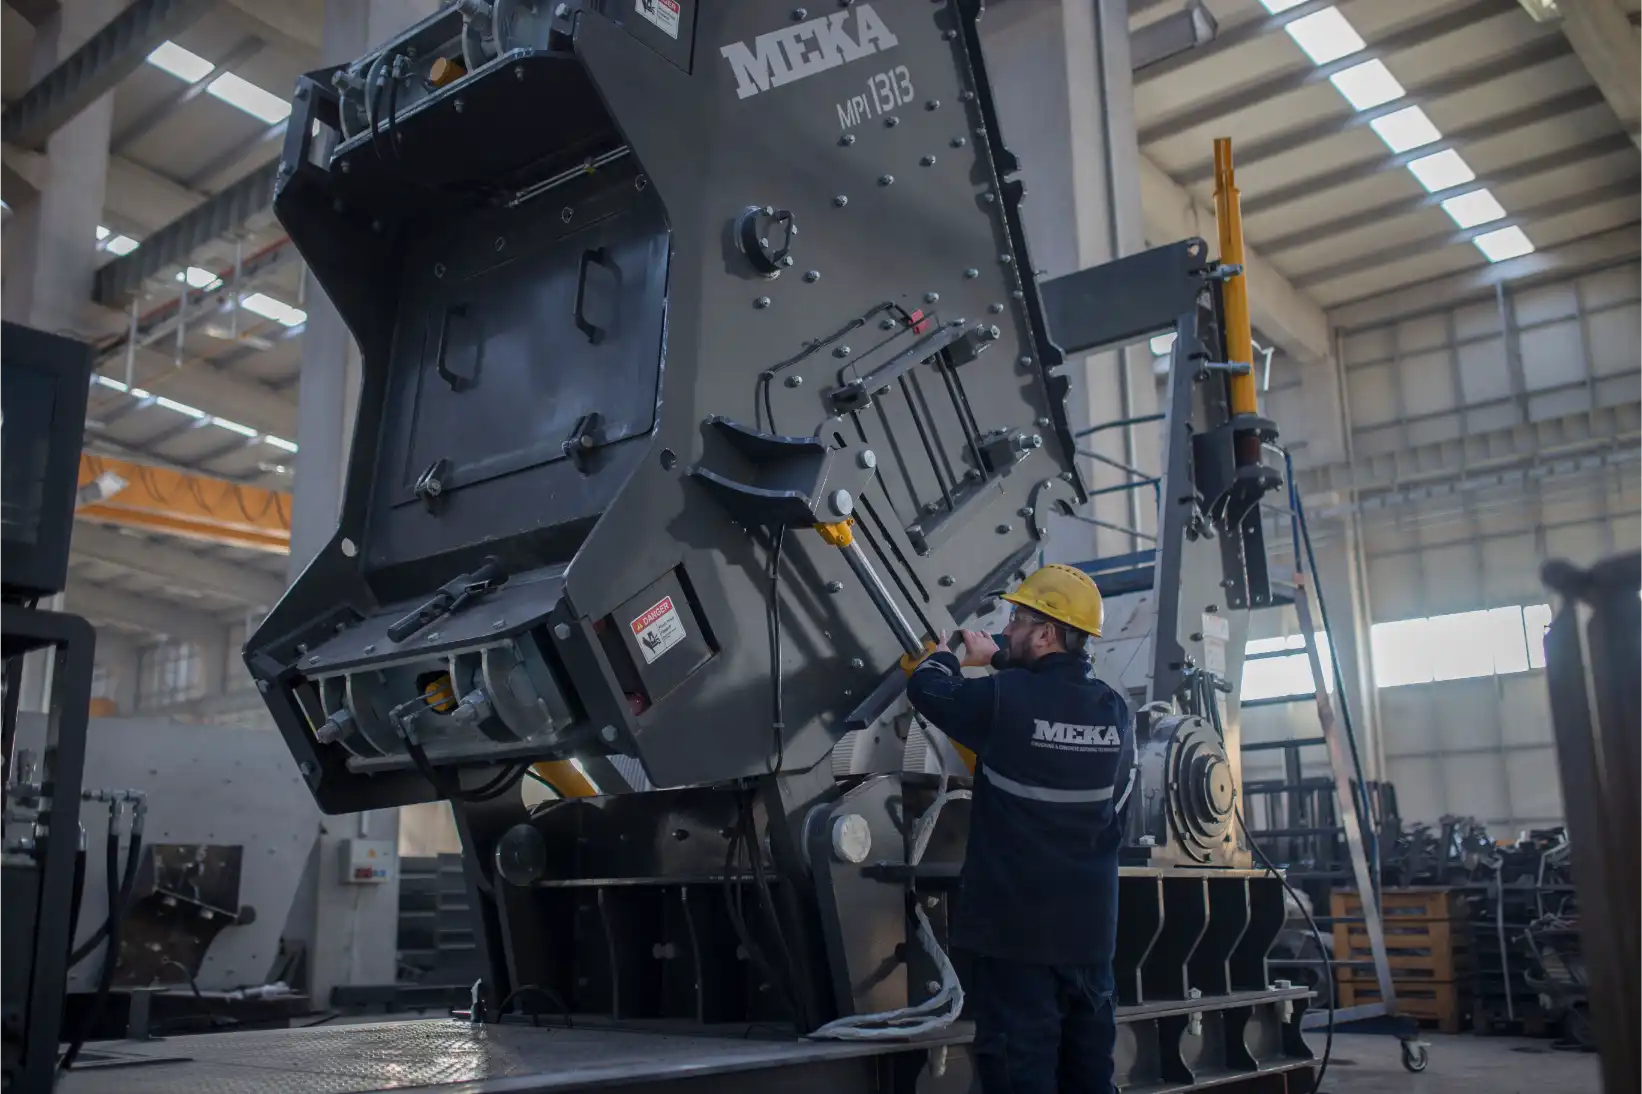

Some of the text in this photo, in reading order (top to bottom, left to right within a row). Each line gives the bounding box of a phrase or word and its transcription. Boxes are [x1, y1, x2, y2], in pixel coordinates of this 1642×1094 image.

[720, 3, 899, 100] MEKA
[836, 65, 914, 129] MPI 1313
[642, 602, 670, 626] DANGER
[1032, 718, 1120, 745] MEKA
